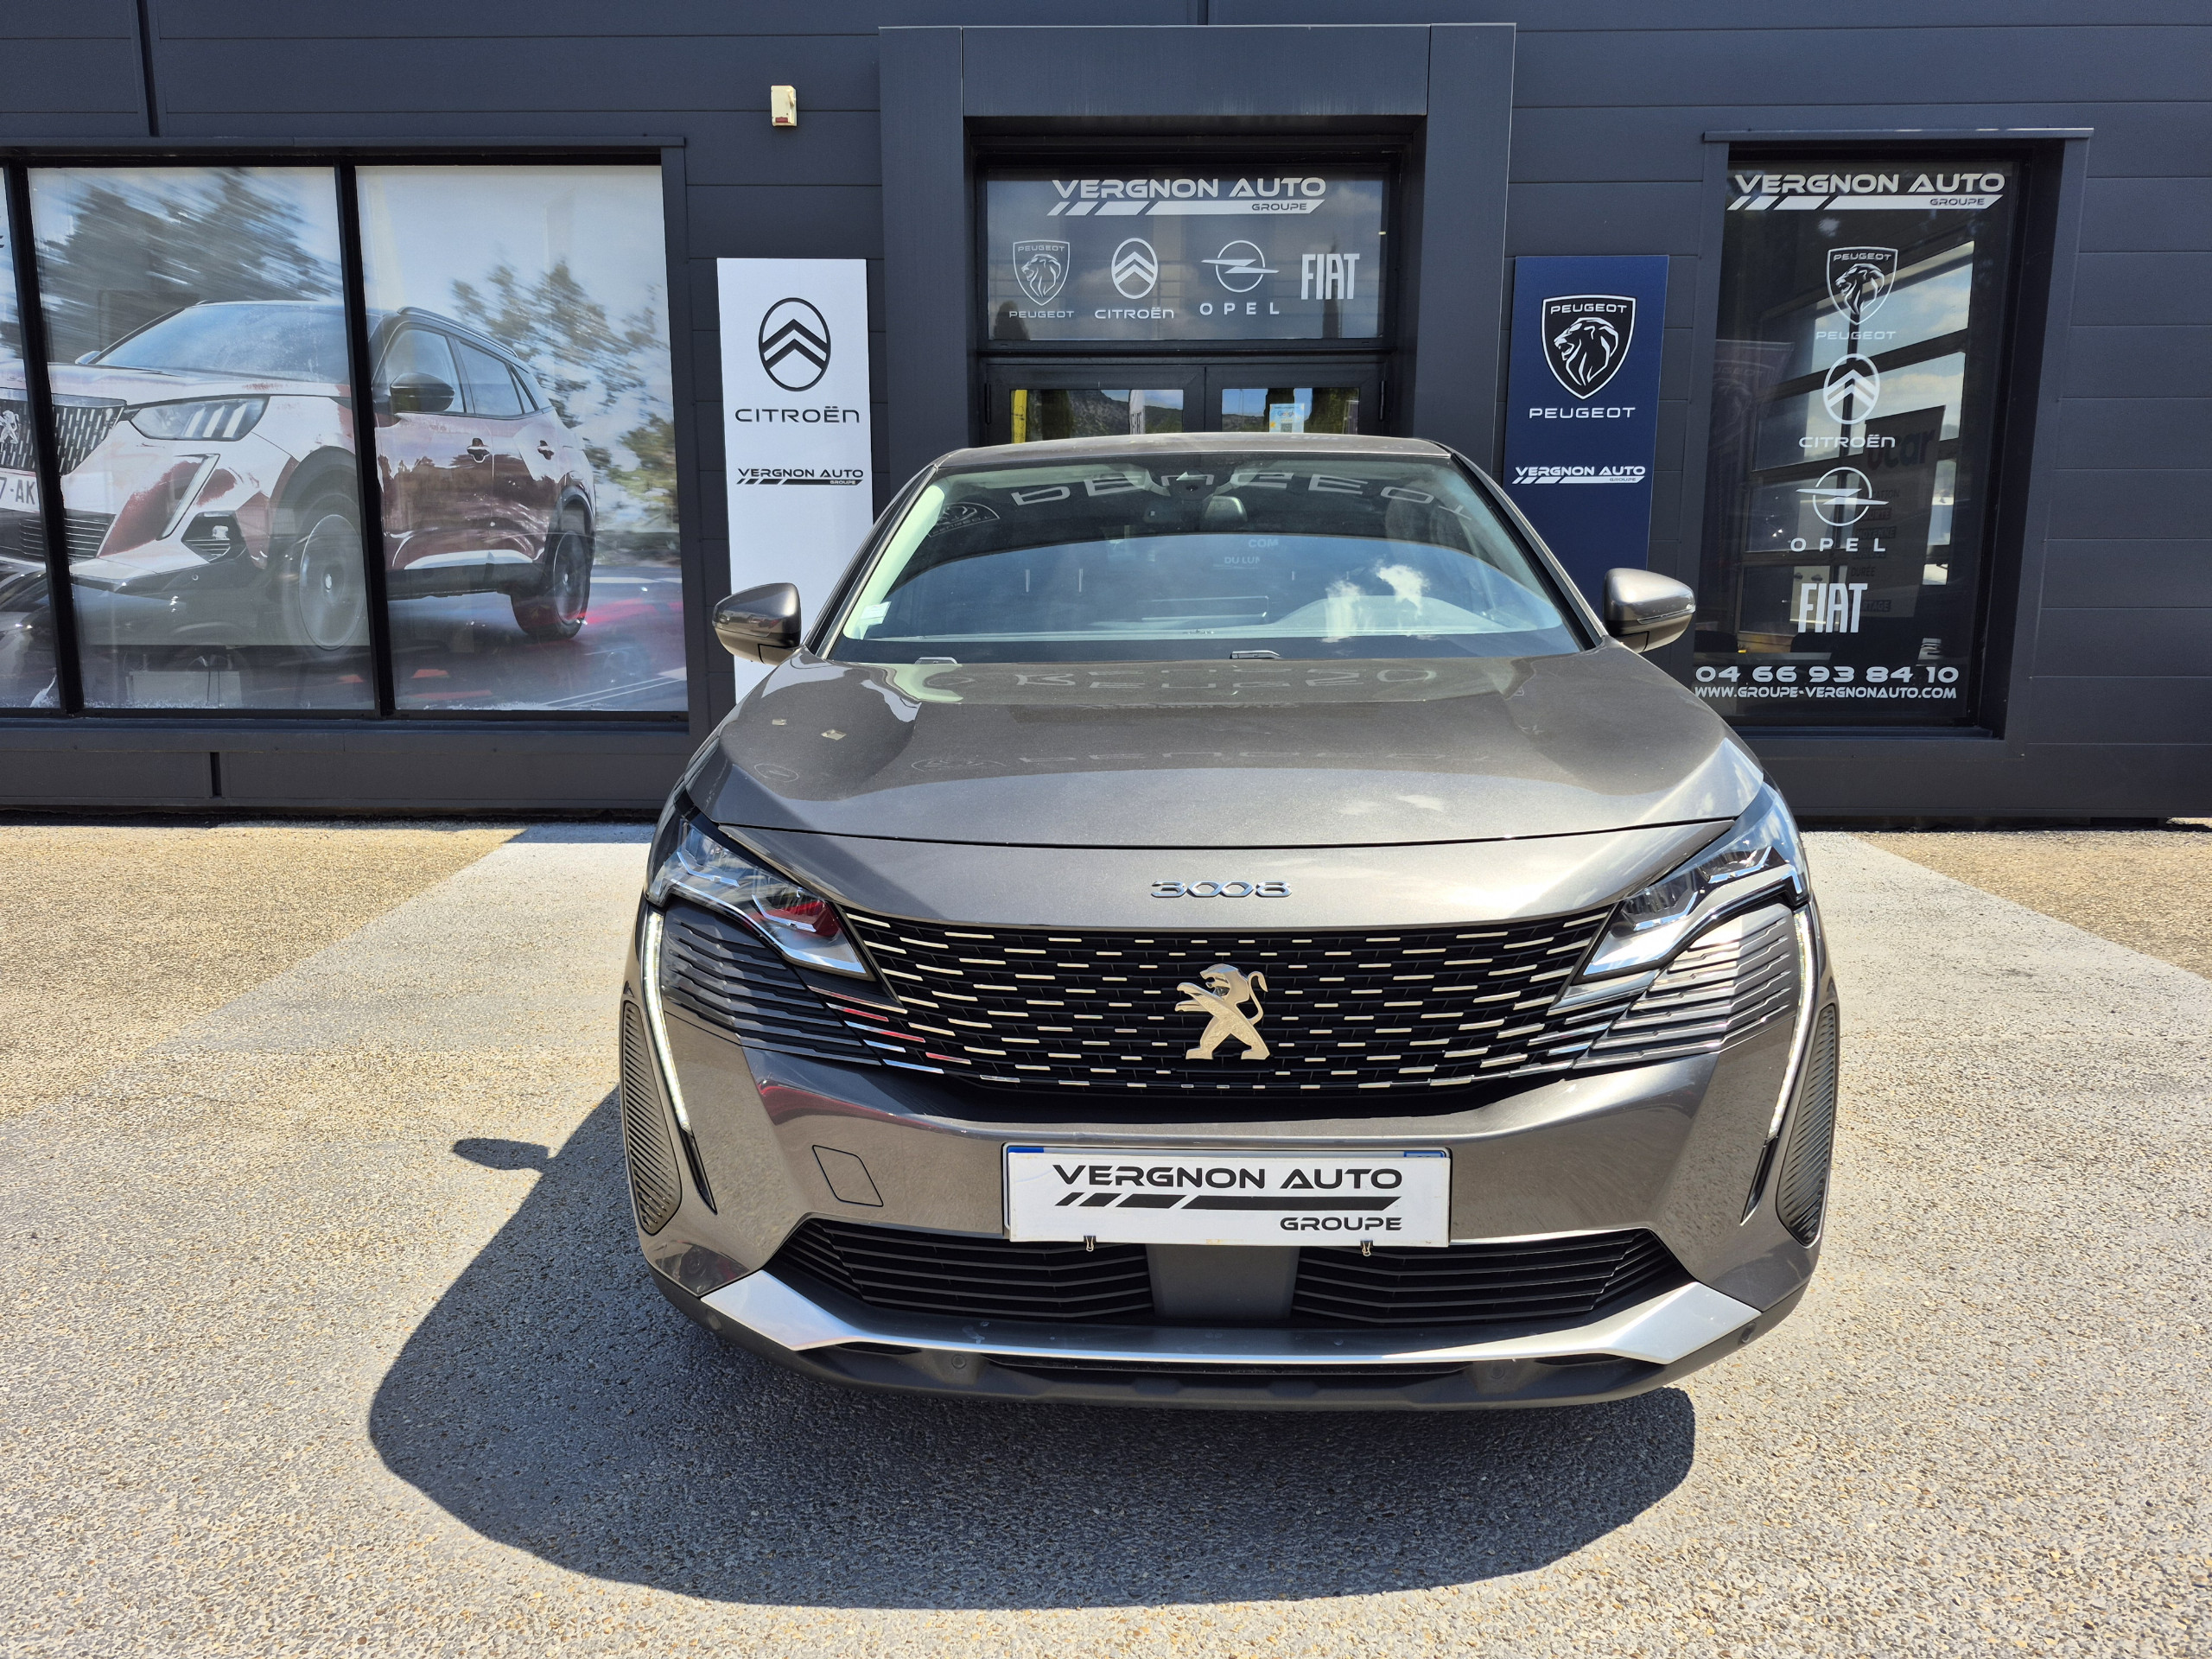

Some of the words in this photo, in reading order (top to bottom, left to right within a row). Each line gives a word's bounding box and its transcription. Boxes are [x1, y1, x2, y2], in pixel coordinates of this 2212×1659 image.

[1052, 178, 1219, 200] VERGNON
[1229, 176, 1326, 198] AUTO
[1734, 174, 1900, 194] VERGNON
[1907, 173, 2005, 193] AUTO
[1251, 202, 1307, 211] GROUPE
[1833, 252, 1892, 262] PEUGEOT
[1300, 253, 1360, 301] FIAT
[1008, 310, 1075, 319] PEUGEOT
[1094, 307, 1175, 320] CITROËN
[1199, 302, 1281, 315] OPEL
[1551, 303, 1627, 315] PEUGEOT
[1815, 331, 1897, 340] PEUGEOT
[735, 406, 860, 423] CITROËN
[1529, 407, 1636, 419] PEUGEOT
[1799, 434, 1896, 448] CITROËN
[738, 468, 815, 478] VERGNON
[820, 469, 864, 478] AUTO
[1516, 467, 1595, 476] VERGNON
[1599, 466, 1646, 476] AUTO
[1790, 537, 1886, 552] OPEL
[1797, 582, 1868, 633] FIAT
[1695, 666, 1741, 683] 04
[1751, 666, 1798, 683] 66
[1808, 666, 1855, 683] 93
[1866, 666, 1913, 683] 84
[1925, 666, 1960, 683] 10
[1694, 686, 1957, 699] WWW.GROUPE-VERGNONAUTO.COM
[1151, 880, 1292, 898] 3008
[1053, 1165, 1266, 1190] VERGNON
[1280, 1168, 1402, 1190] AUTO
[1280, 1217, 1402, 1231] GROUPE
